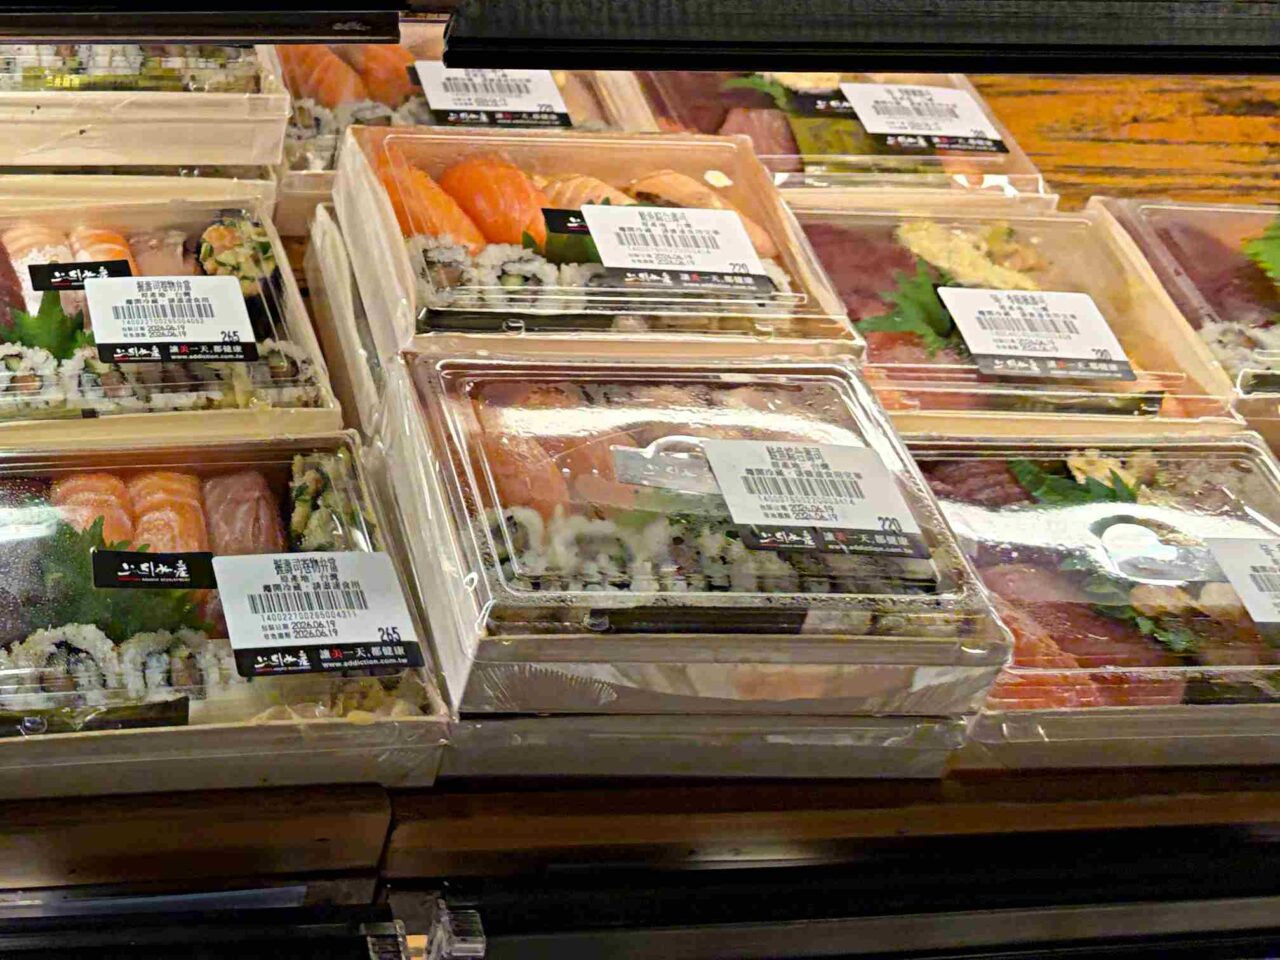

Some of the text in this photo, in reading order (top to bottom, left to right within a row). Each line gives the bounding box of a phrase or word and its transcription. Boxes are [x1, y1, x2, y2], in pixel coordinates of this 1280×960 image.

[220, 330, 240, 343] 265
[291, 620, 335, 629] 2026.06.19
[293, 629, 337, 639] 2026.06.19
[378, 627, 400, 643] 265
